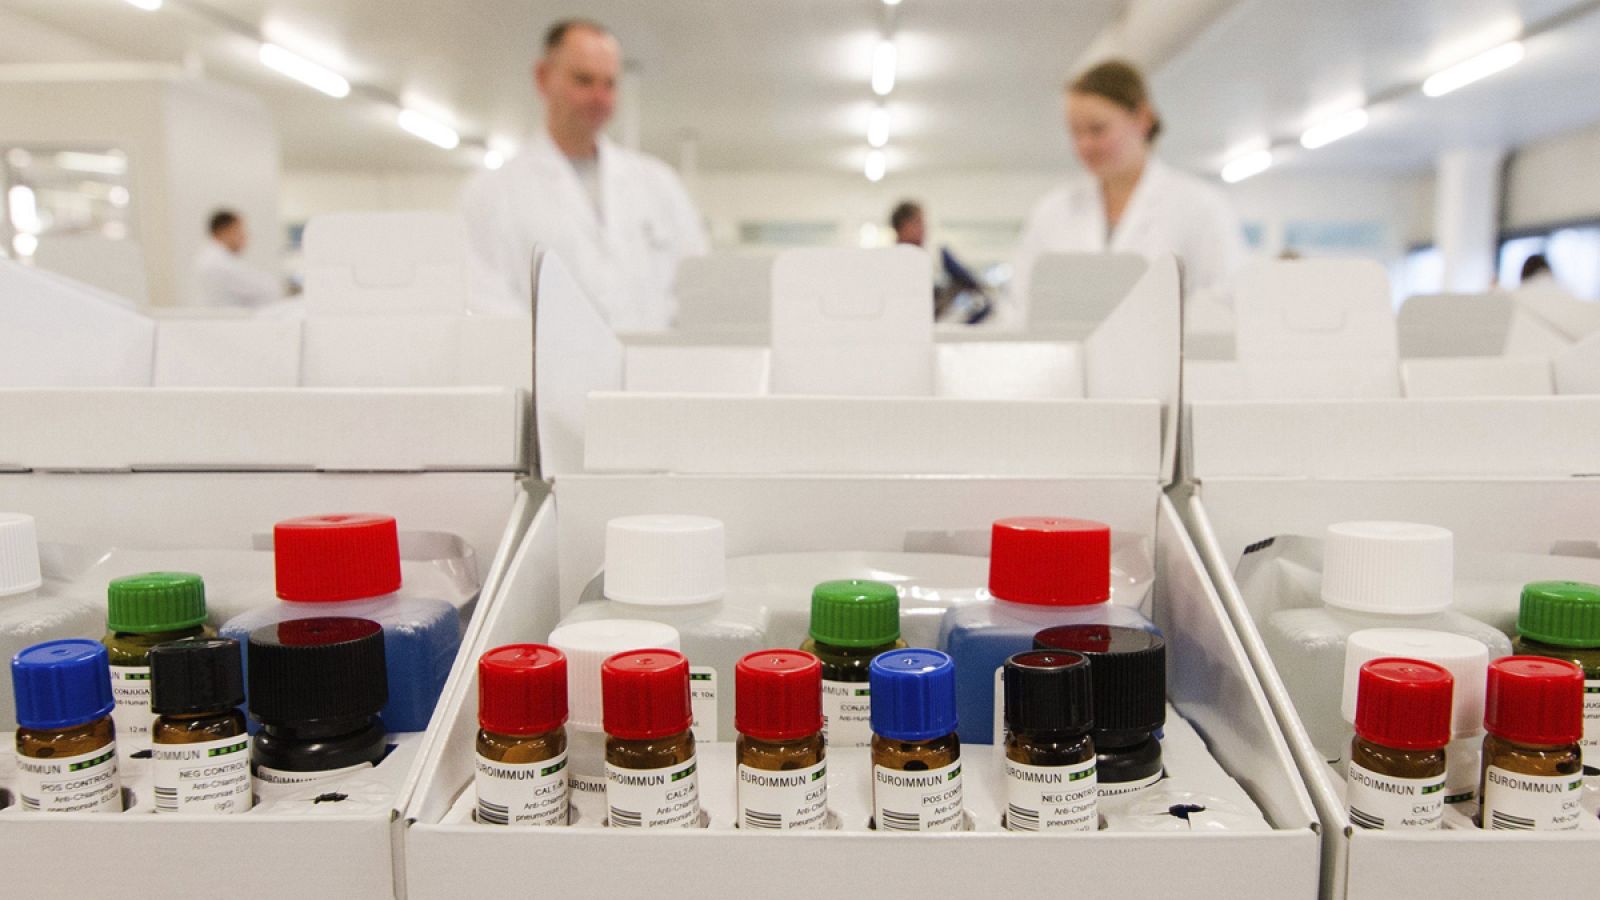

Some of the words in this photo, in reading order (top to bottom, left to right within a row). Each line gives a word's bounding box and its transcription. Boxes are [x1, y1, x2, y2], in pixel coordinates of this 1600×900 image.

[152, 749, 200, 761] OIMMUN
[179, 769, 201, 779] NEG
[203, 761, 245, 777] CONTROL
[740, 769, 806, 787] EUROIMMUN
[876, 771, 942, 787] EUROIMMUN
[41, 783, 62, 792] POS
[64, 771, 110, 791] CONTROL
[1349, 766, 1415, 795] EUROIMMUN
[1487, 771, 1563, 794] EUROIMMUN
[922, 795, 942, 805] POS
[1042, 794, 1063, 803] NEG
